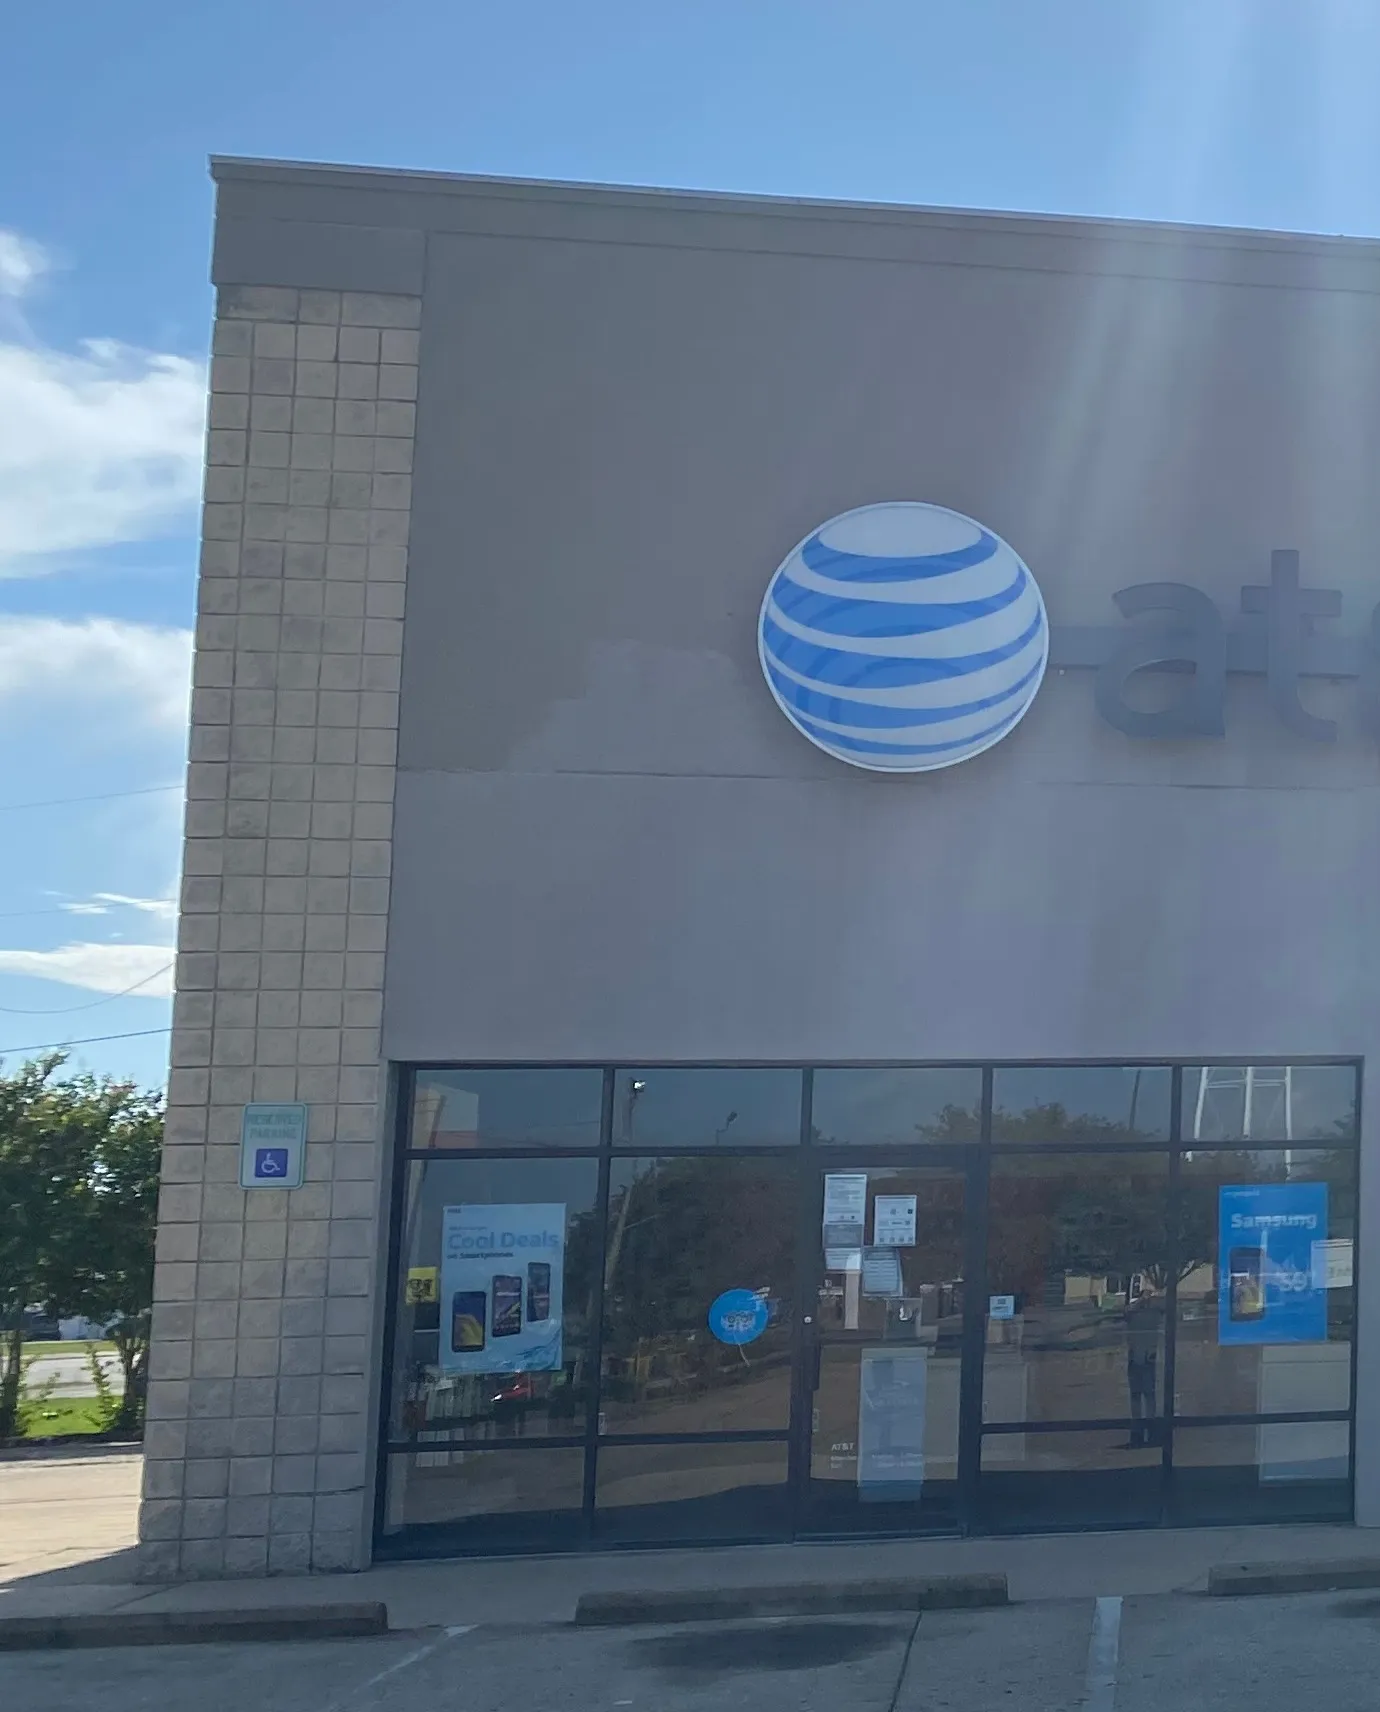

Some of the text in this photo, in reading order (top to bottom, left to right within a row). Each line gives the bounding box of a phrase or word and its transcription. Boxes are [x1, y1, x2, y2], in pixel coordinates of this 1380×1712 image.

[1231, 1213, 1317, 1230] Samsung
[448, 1230, 559, 1250] Cool Deals
[831, 1442, 855, 1452] AT&T
